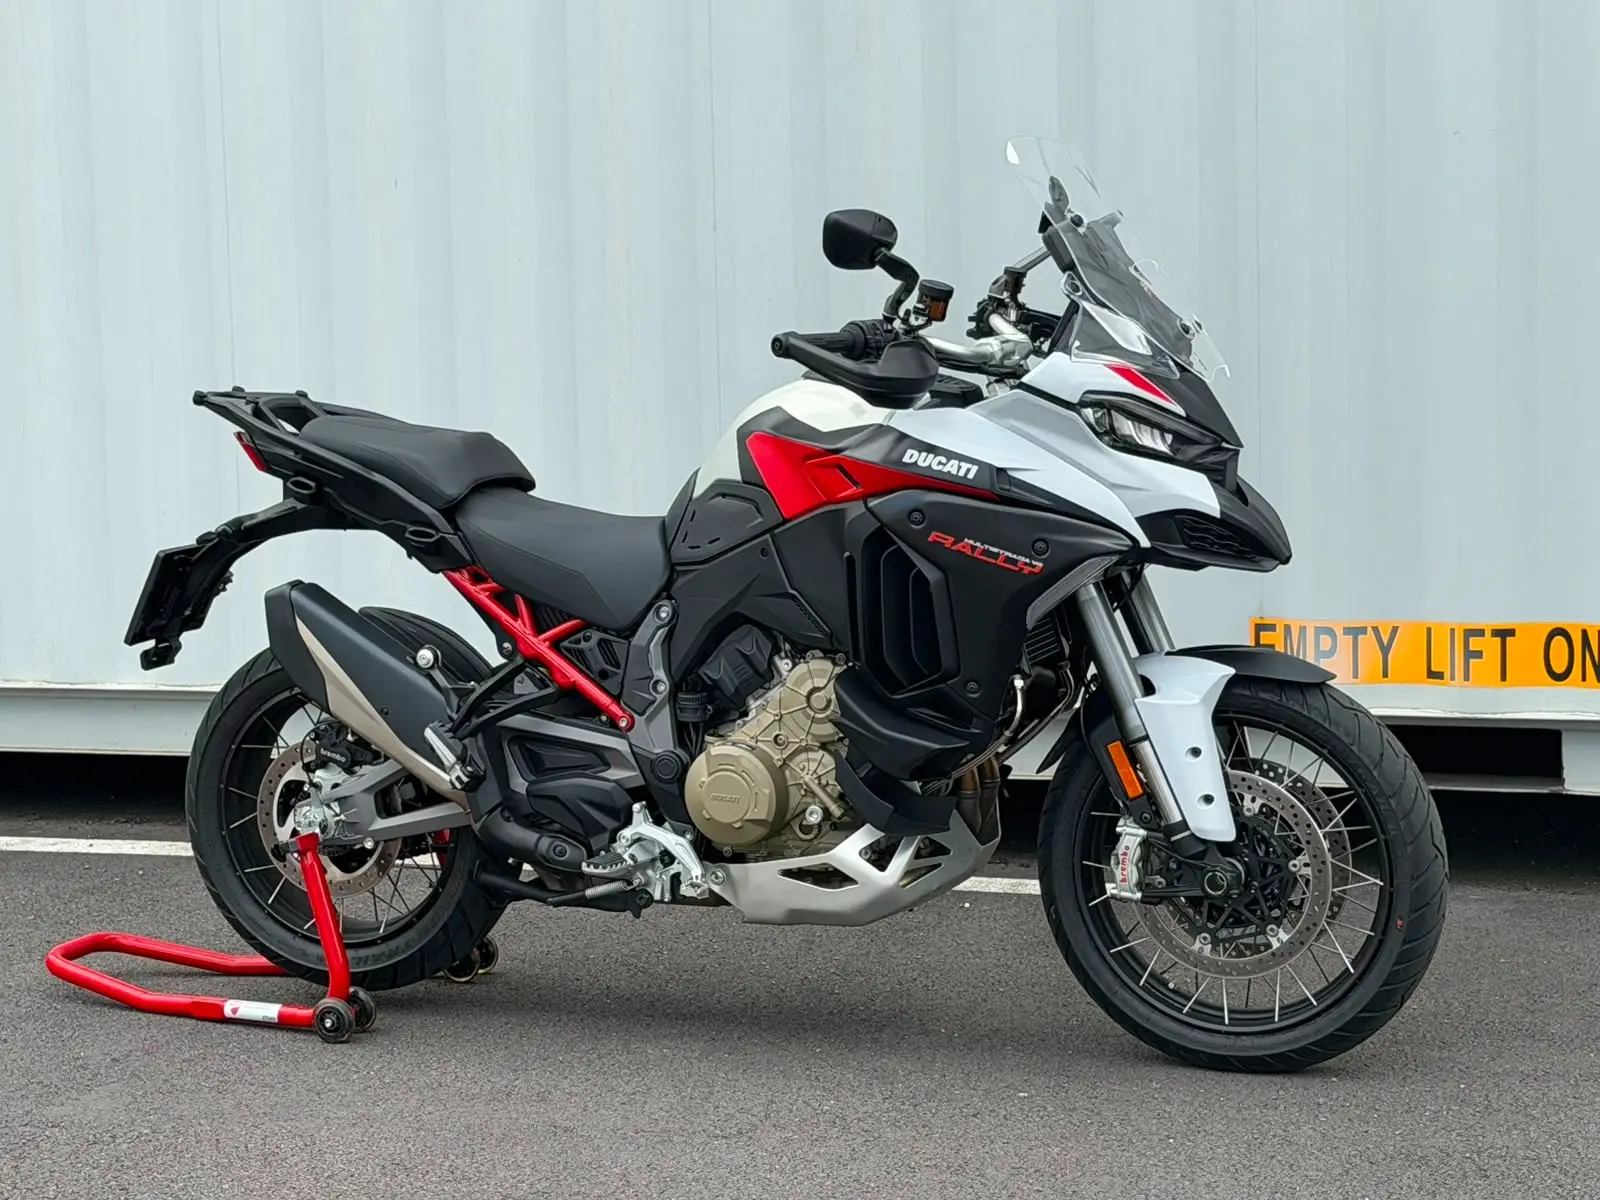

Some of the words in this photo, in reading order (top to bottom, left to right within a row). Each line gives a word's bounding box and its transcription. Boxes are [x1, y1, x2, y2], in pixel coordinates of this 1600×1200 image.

[901, 448, 979, 479] DUCATI
[927, 531, 1044, 575] RALLY
[1426, 626, 1516, 683] LIFT
[1543, 626, 1600, 684] ON
[320, 747, 346, 763] brembo
[1119, 845, 1130, 884] brembo
